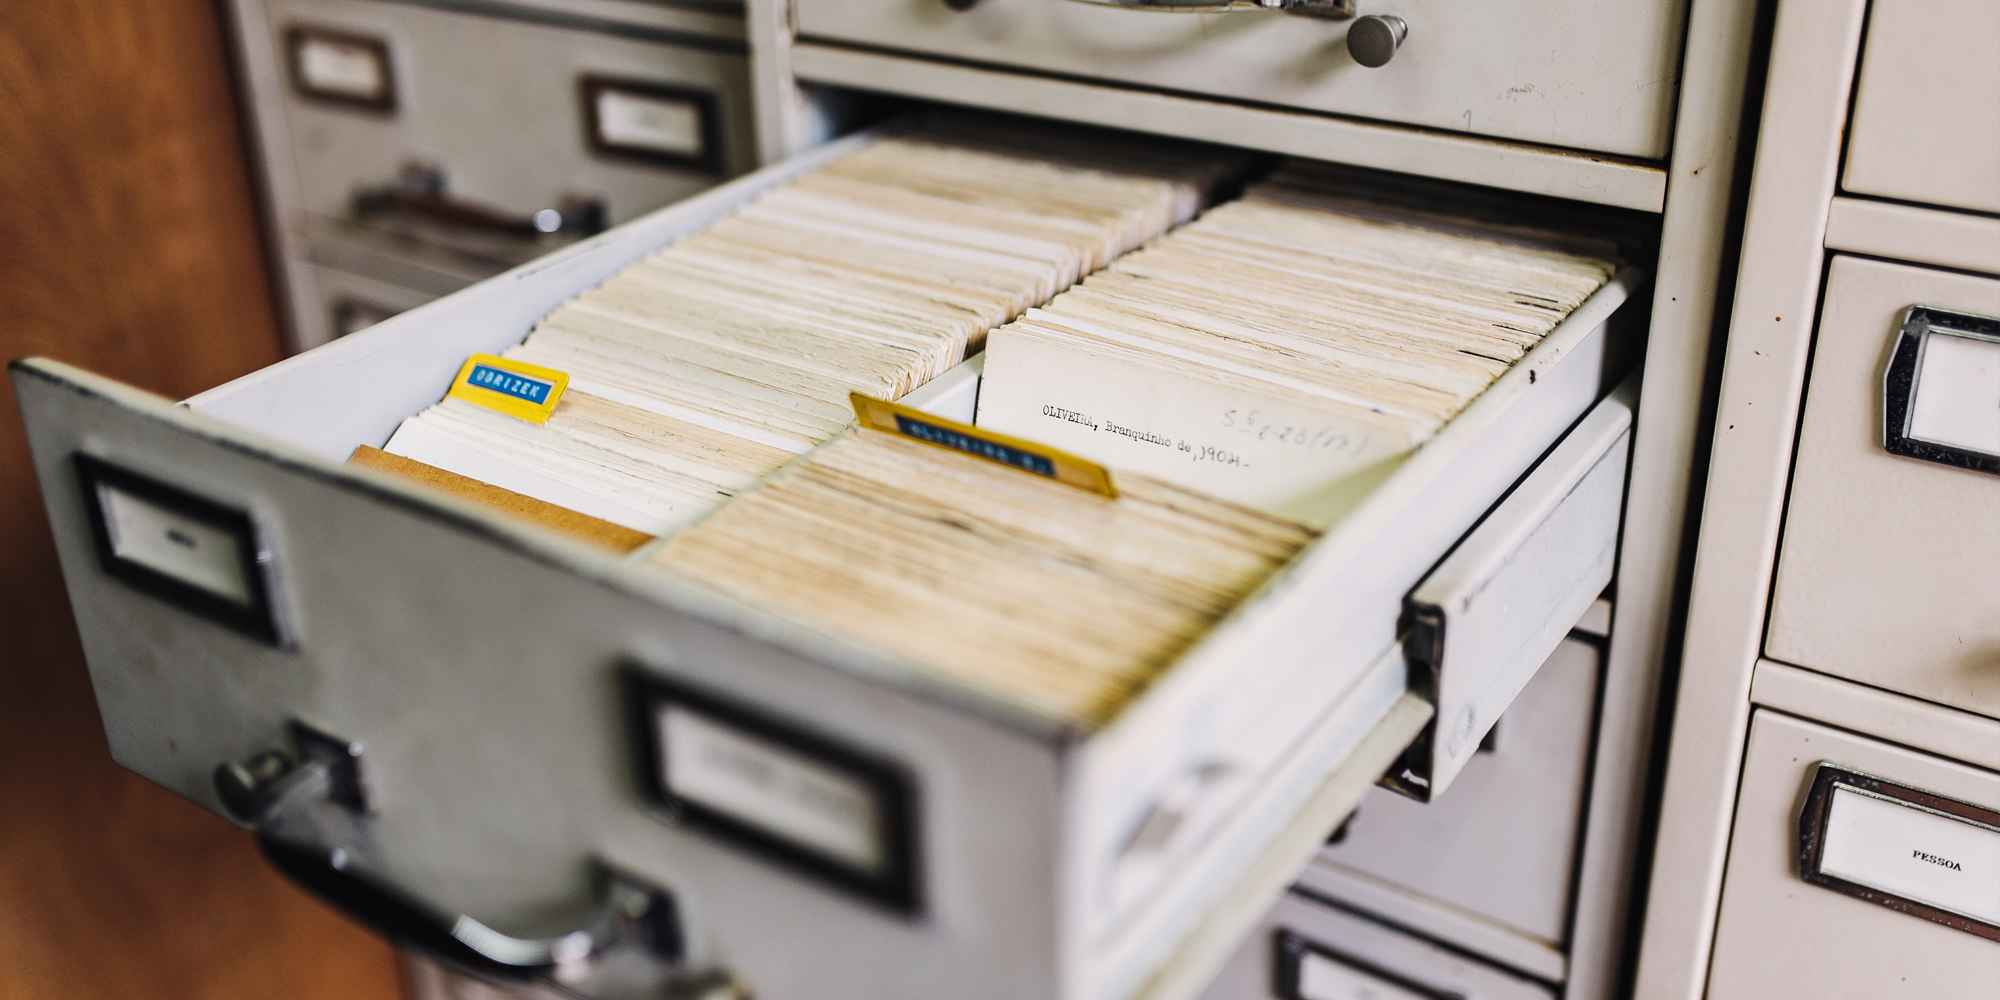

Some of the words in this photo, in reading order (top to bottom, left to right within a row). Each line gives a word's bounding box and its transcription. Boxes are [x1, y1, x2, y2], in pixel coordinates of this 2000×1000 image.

[1042, 404, 1099, 431] OLIVEIRA,
[1105, 421, 1172, 448] Branquinho
[1912, 850, 1962, 872] PESSOA
